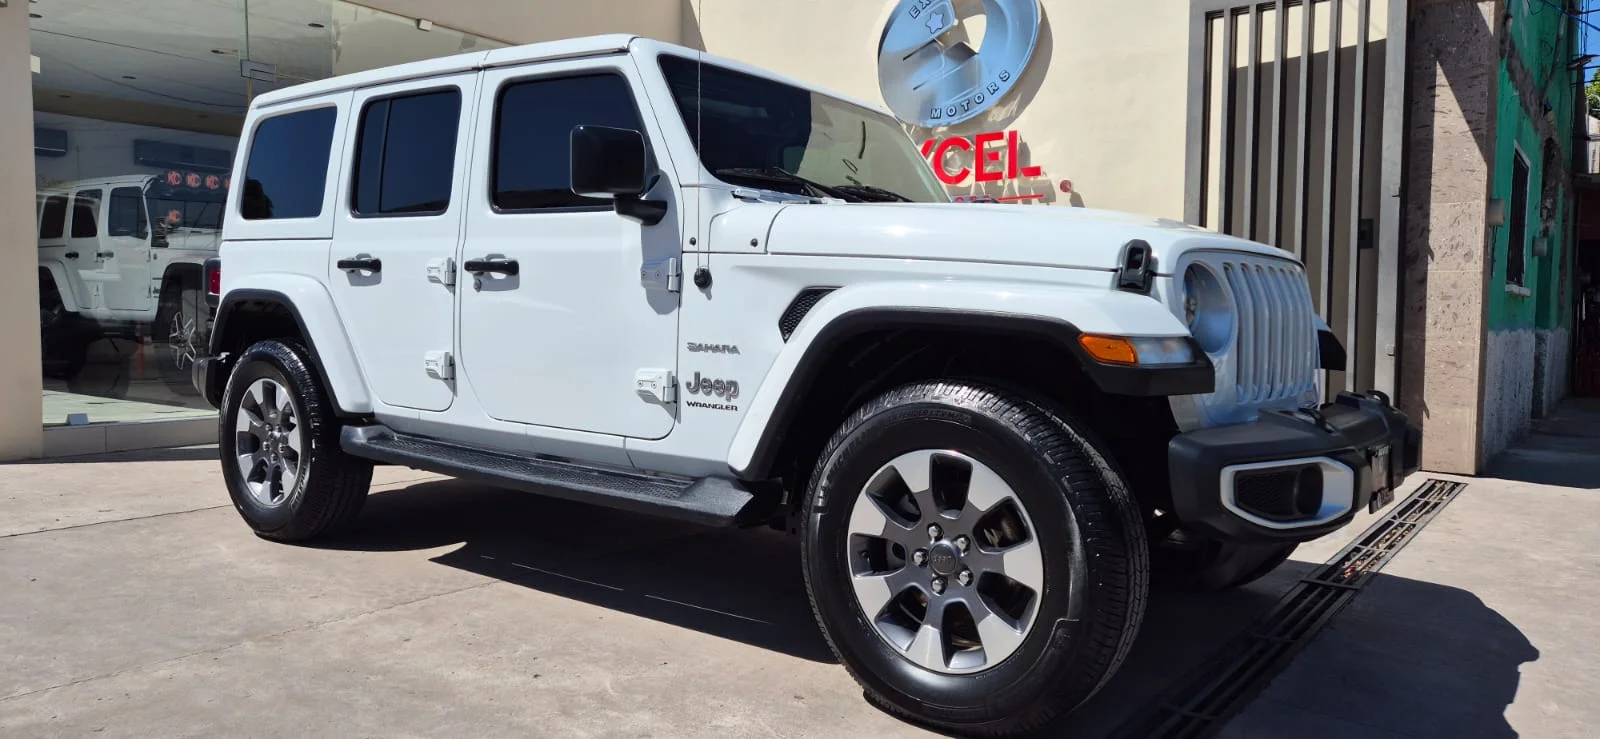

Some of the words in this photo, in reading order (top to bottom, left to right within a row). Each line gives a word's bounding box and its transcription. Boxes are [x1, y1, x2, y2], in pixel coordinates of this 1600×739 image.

[930, 70, 1011, 119] MOTORS
[687, 342, 740, 355] SAHARA
[686, 371, 740, 402] Jeep
[686, 401, 738, 411] WRANGLER
